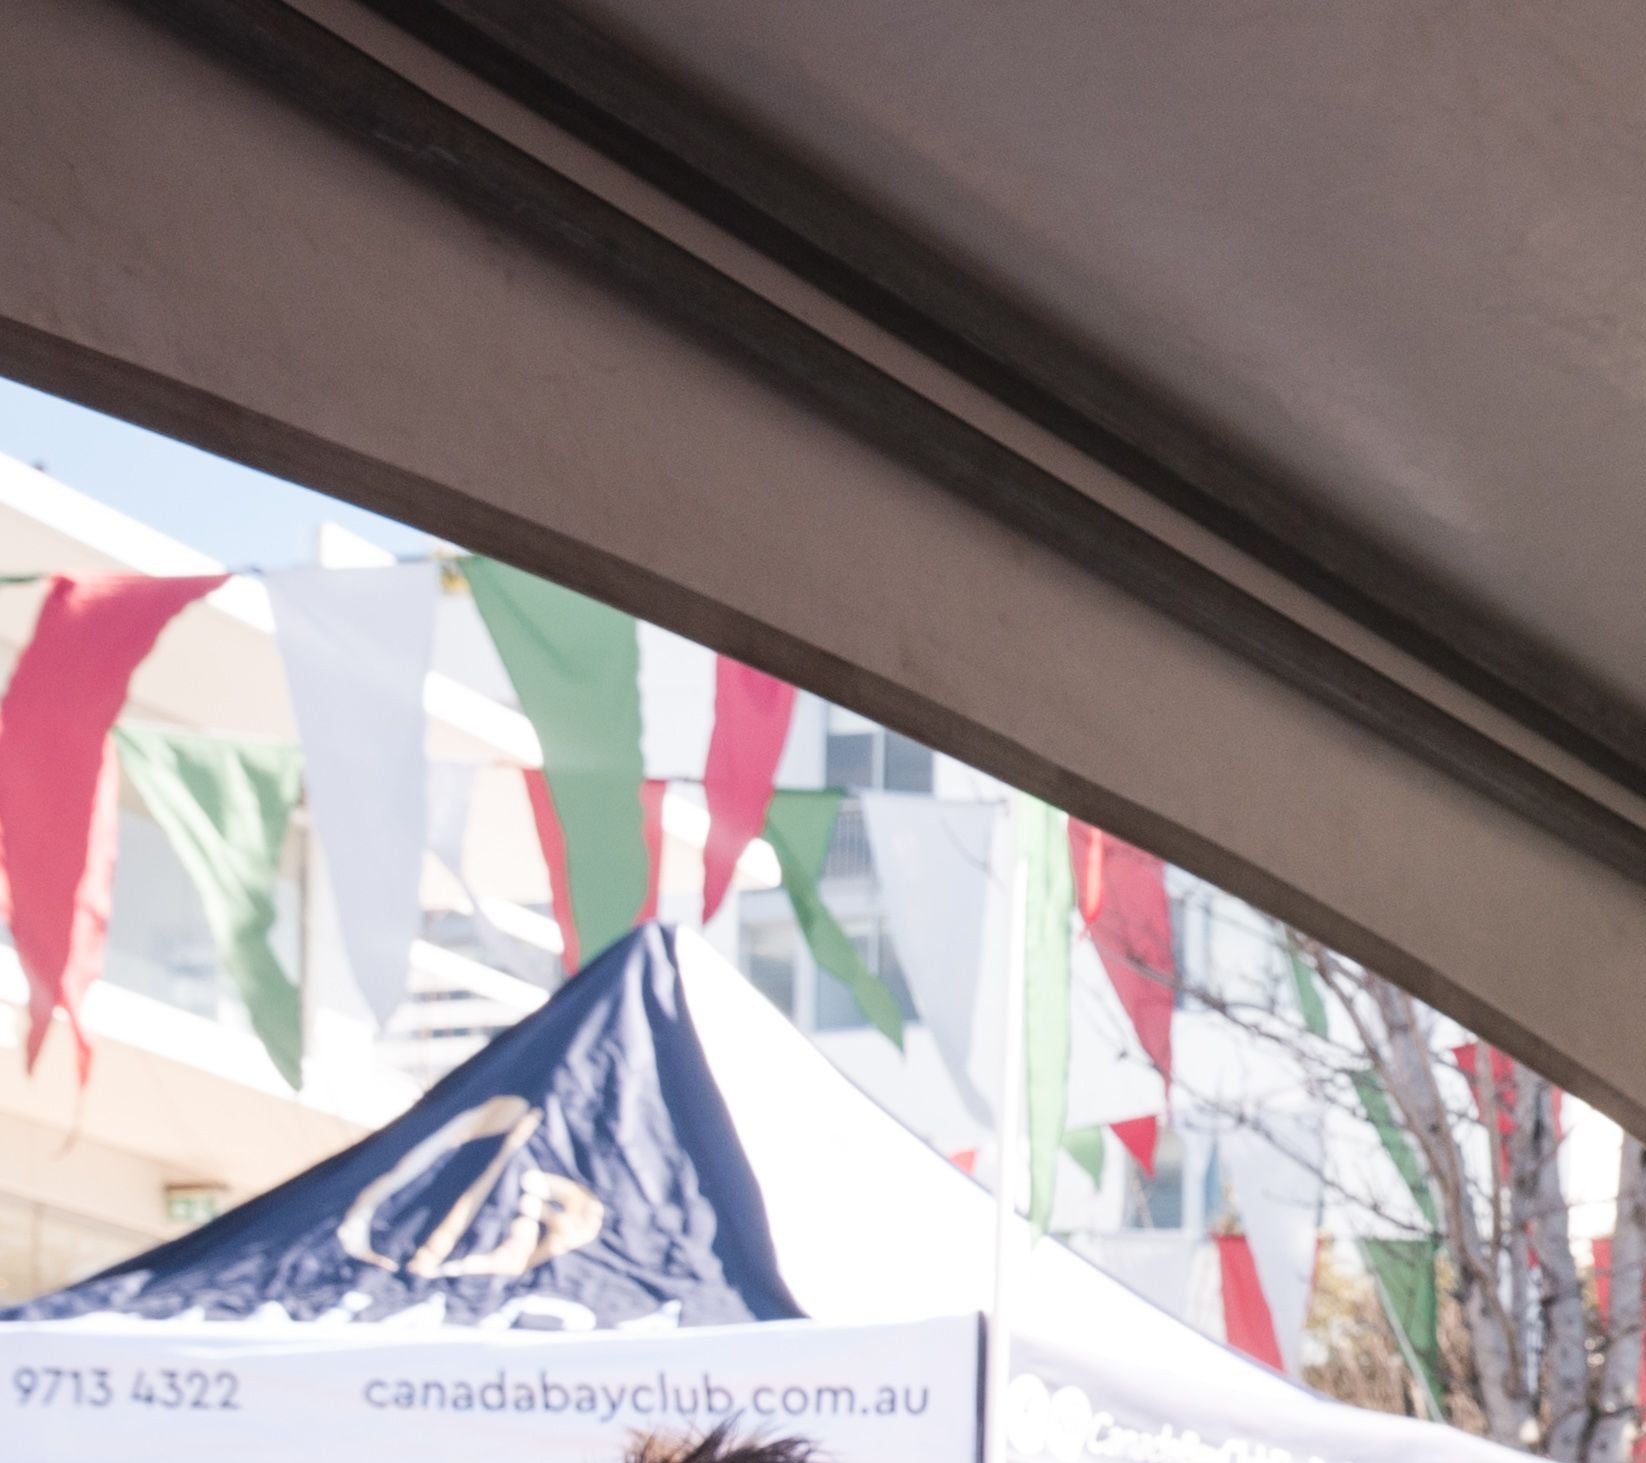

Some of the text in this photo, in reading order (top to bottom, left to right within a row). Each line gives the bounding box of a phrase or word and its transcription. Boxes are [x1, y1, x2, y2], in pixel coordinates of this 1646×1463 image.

[12, 1366, 242, 1412] 9713 4322
[362, 1369, 931, 1422] canadabayclub.com.au
